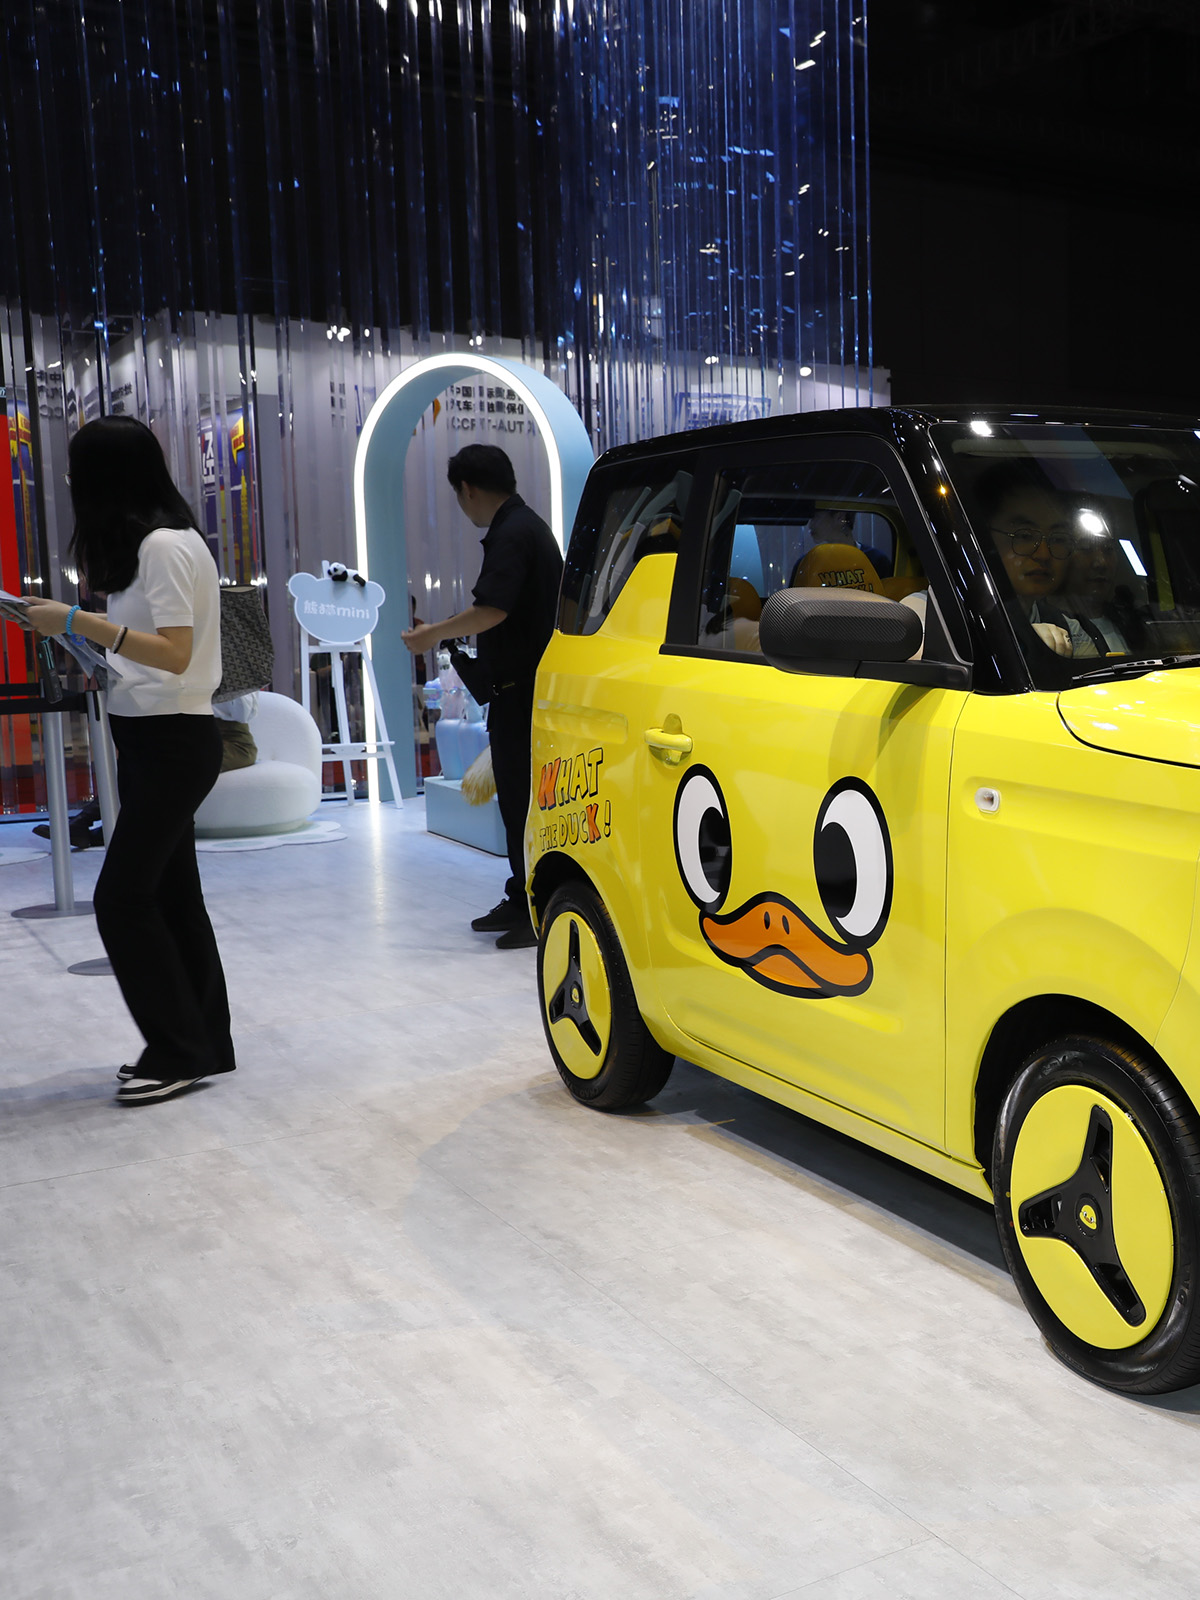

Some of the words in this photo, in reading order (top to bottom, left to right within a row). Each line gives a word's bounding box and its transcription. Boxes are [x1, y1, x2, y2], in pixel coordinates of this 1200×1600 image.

[817, 569, 865, 587] WHAT
[538, 747, 604, 811] WHAT
[539, 823, 558, 852] THE
